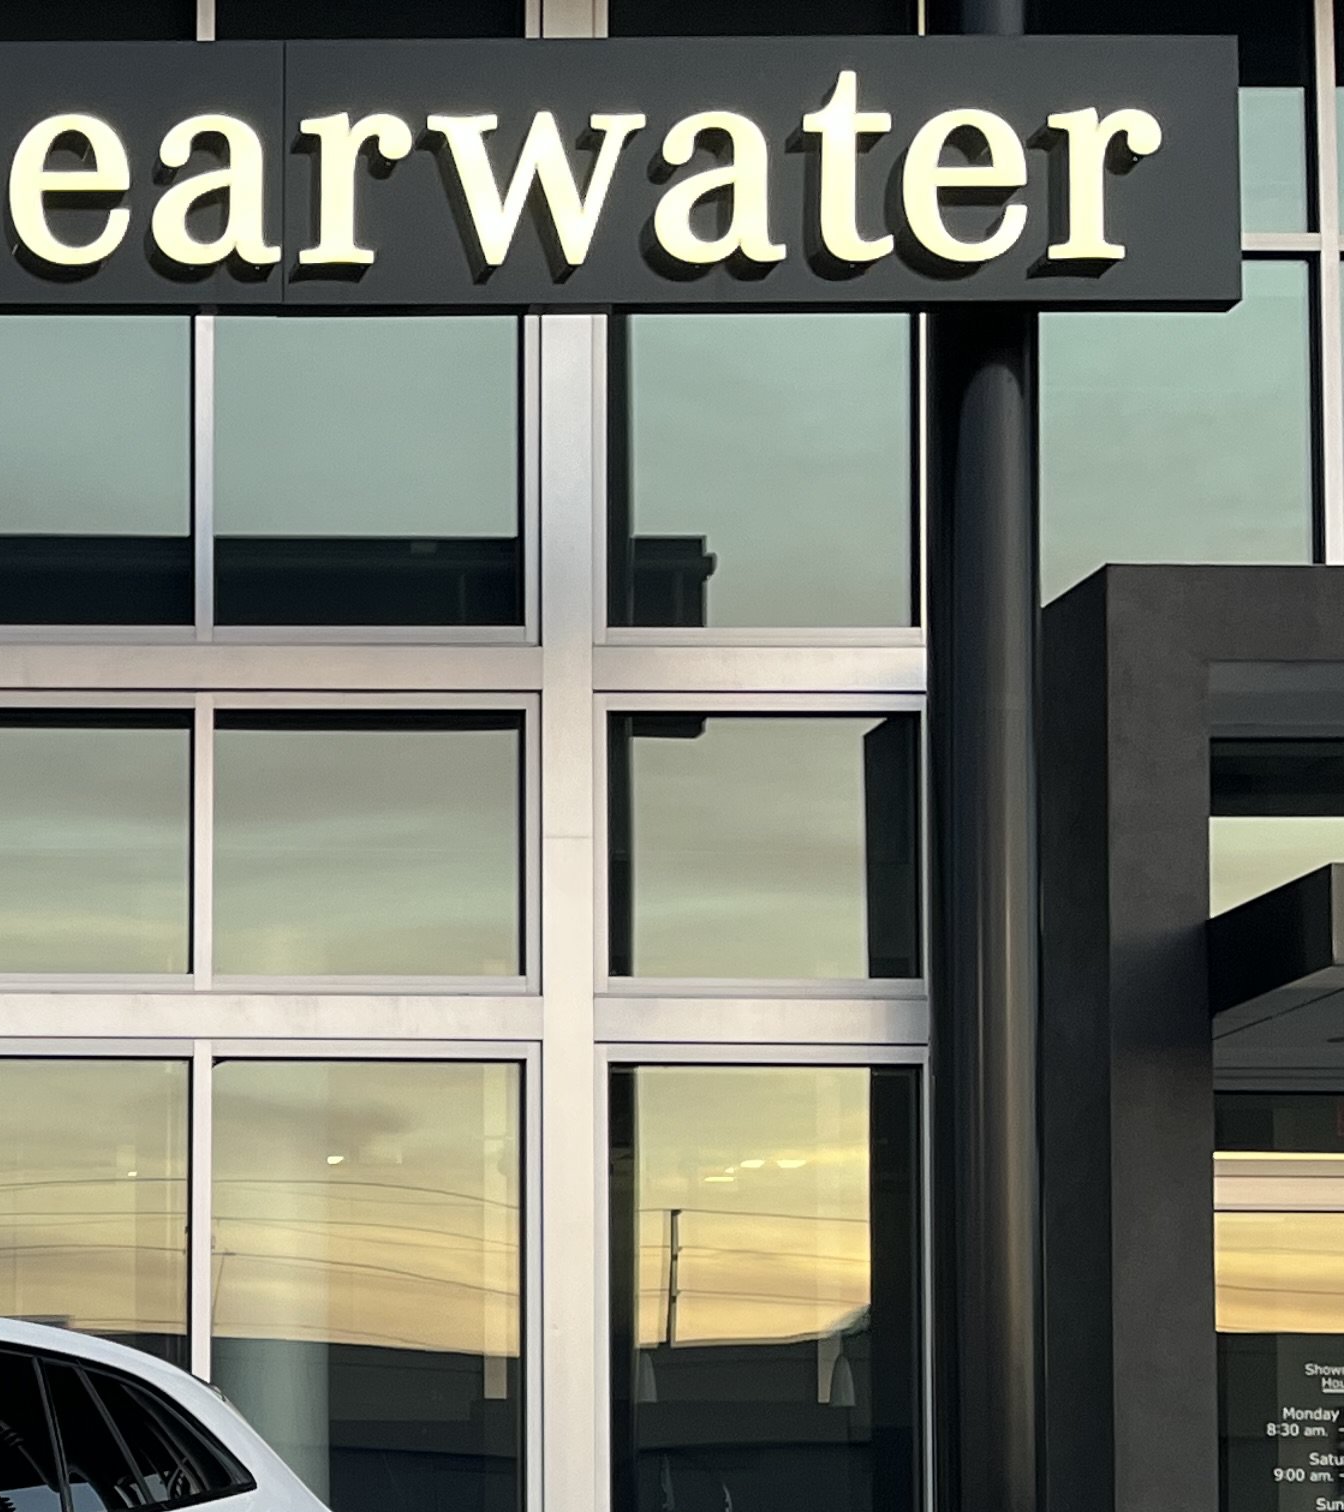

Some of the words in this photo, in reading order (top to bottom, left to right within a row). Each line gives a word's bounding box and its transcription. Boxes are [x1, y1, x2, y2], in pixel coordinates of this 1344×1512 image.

[1282, 1406, 1340, 1423] Monday
[1266, 1421, 1300, 1438] 8:30
[1303, 1425, 1329, 1438] am.
[1273, 1467, 1305, 1483] 9:00
[1309, 1471, 1335, 1483] am.
